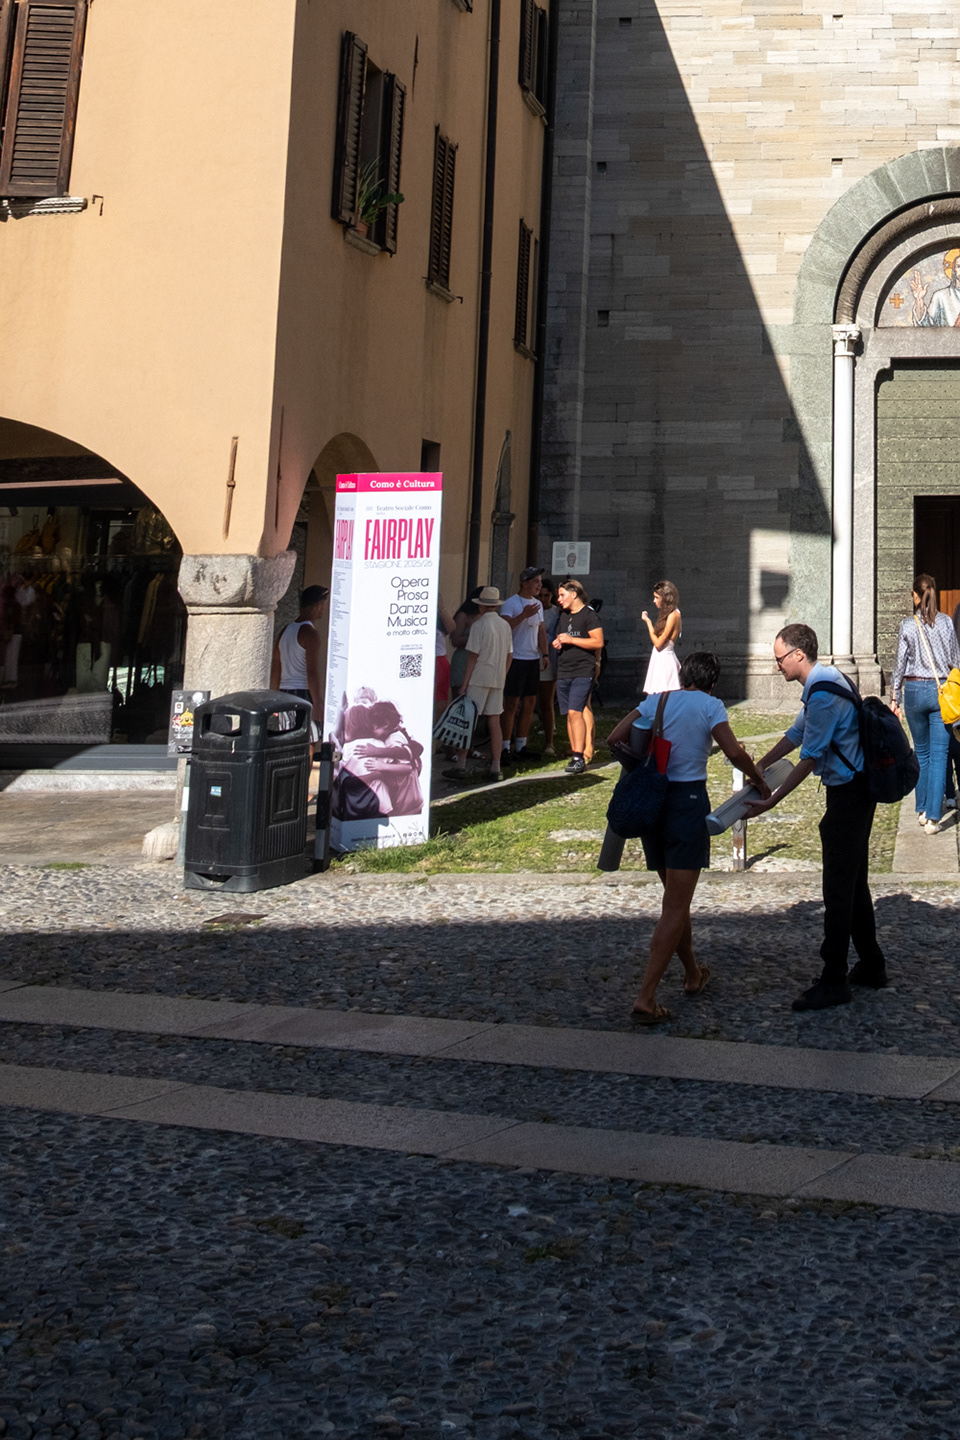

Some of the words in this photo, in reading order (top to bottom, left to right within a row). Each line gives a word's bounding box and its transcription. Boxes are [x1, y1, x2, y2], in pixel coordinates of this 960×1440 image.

[370, 480, 394, 488] Como
[396, 479, 402, 488] è
[403, 480, 435, 488] Cultura
[364, 518, 435, 560] FAIRPLAY
[364, 560, 402, 569] STAGIONE
[404, 559, 433, 568] 2025/26
[390, 576, 430, 590] Opera
[397, 589, 429, 601] Prosa
[390, 603, 428, 615] Danza
[387, 615, 428, 627] Musica
